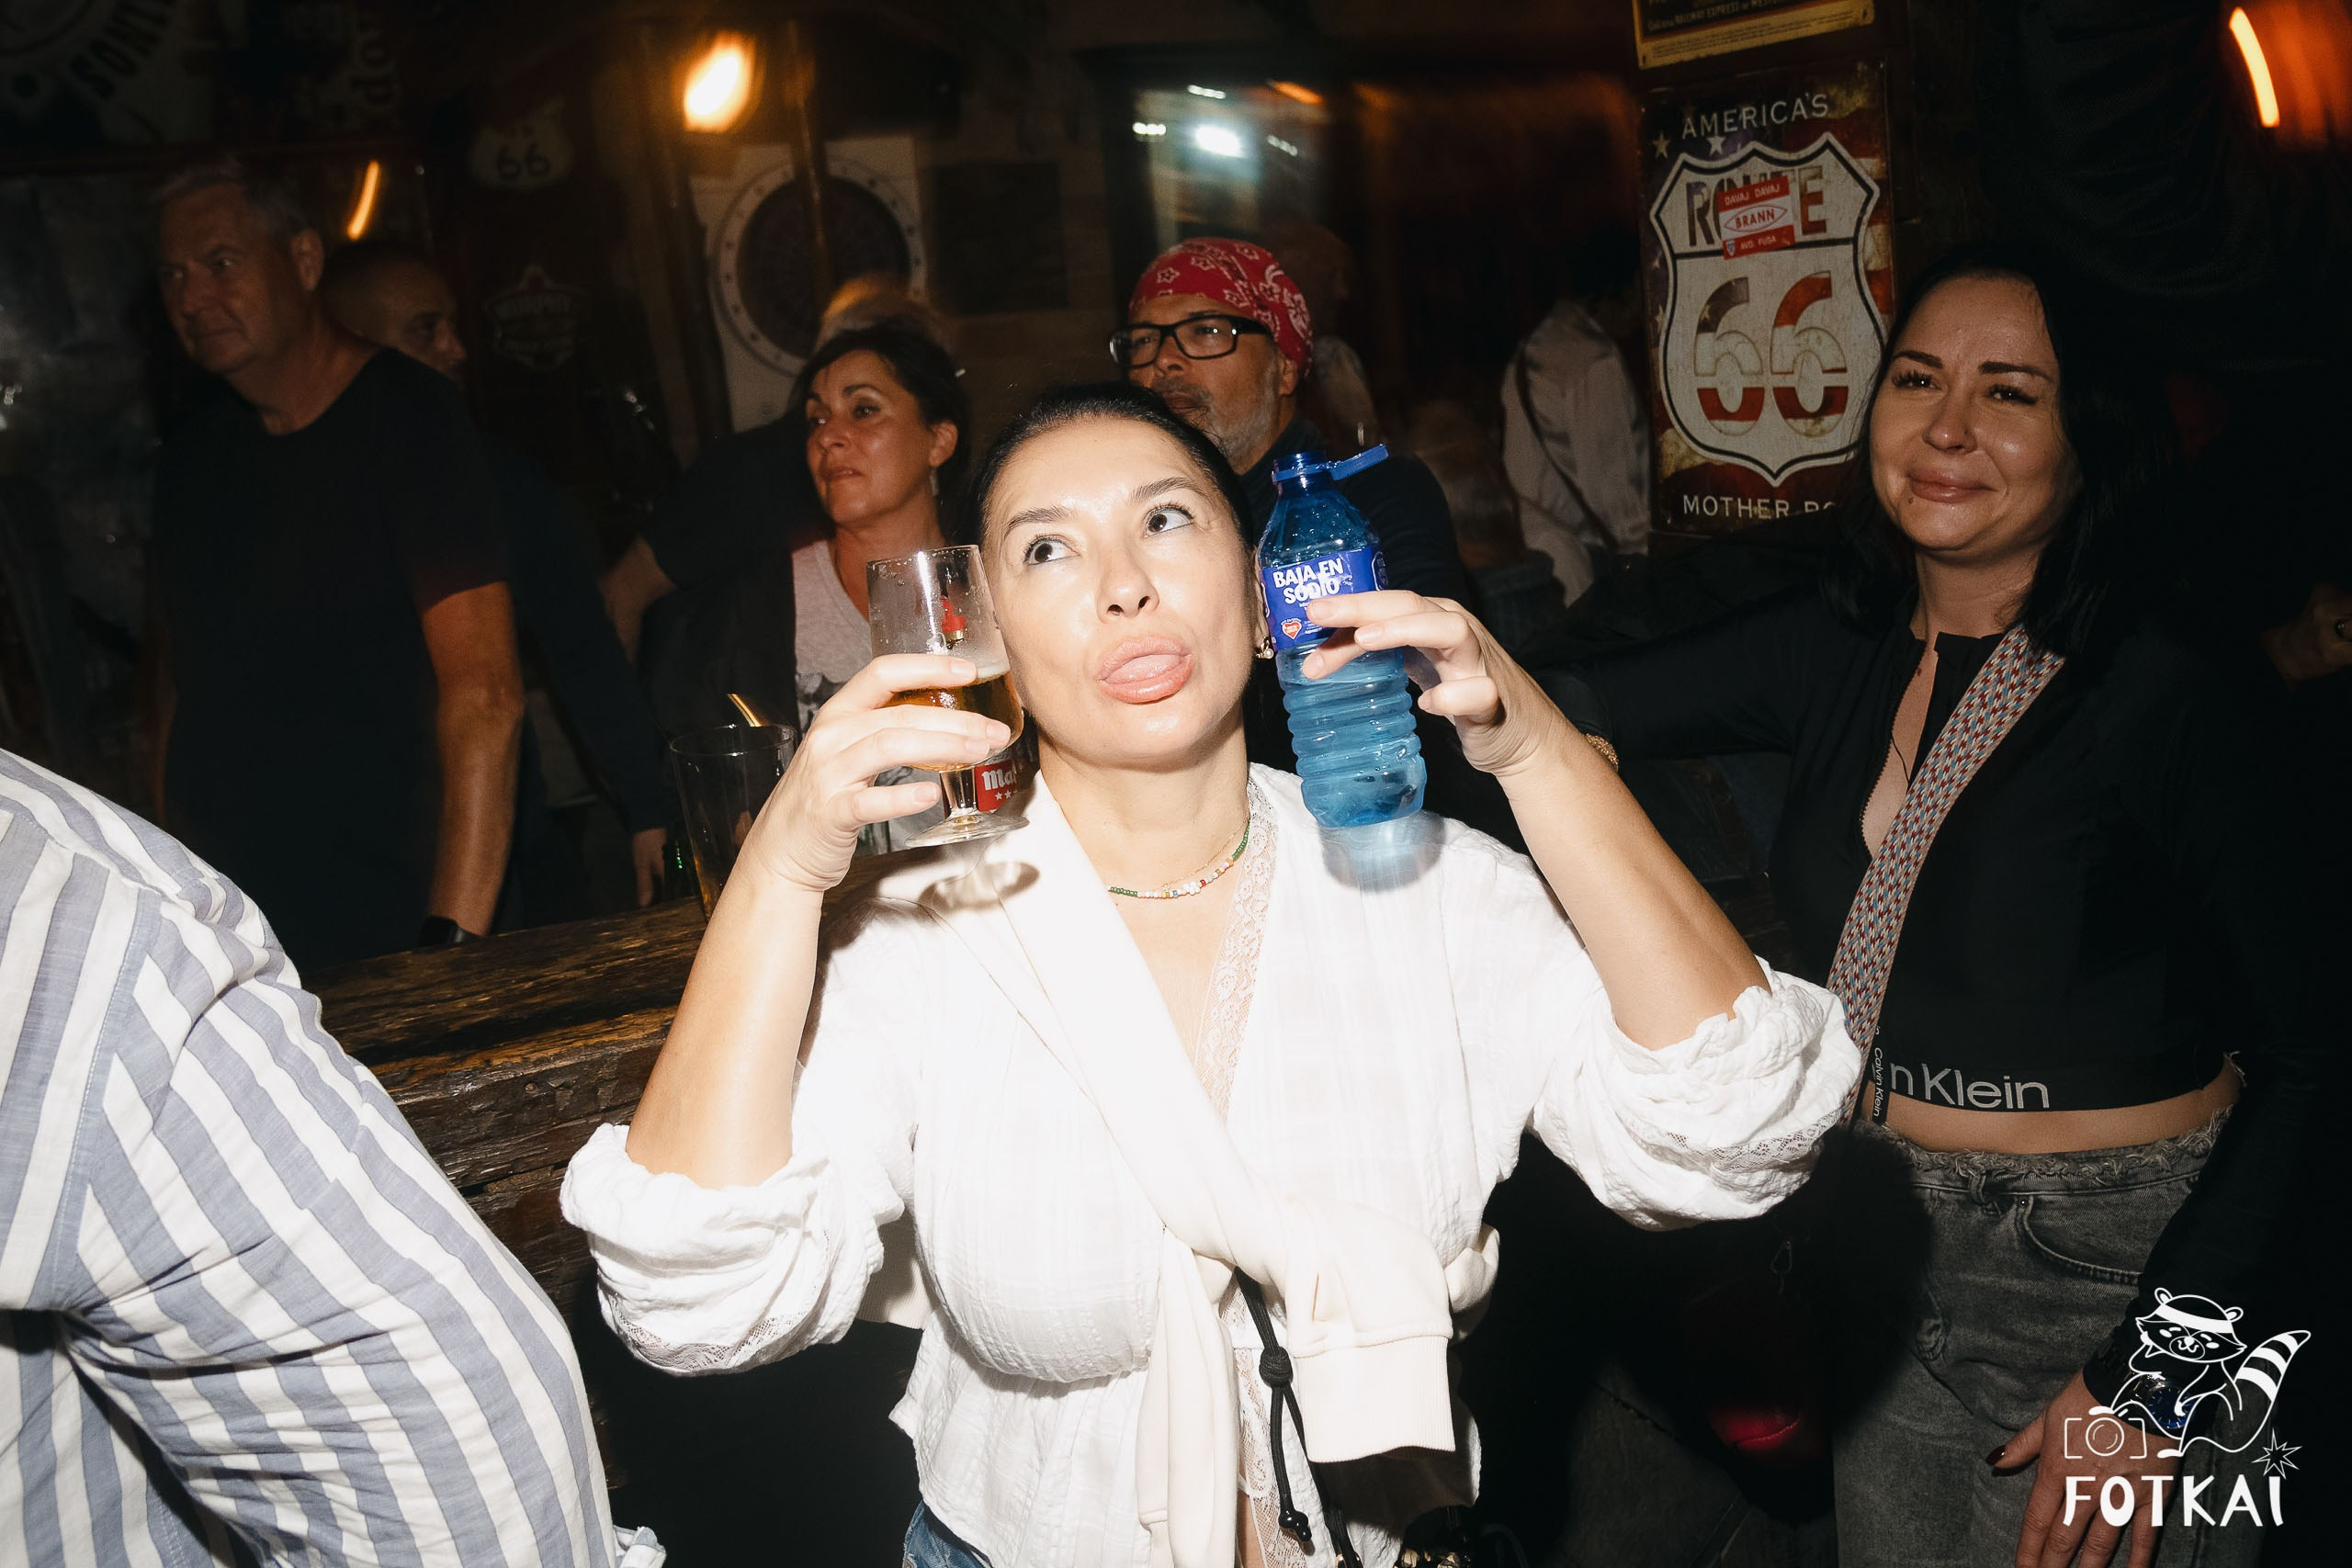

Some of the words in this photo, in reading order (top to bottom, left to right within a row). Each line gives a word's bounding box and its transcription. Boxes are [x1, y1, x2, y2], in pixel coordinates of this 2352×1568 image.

[1682, 93, 1828, 140] AMERICA'S
[497, 141, 550, 181] 66
[1724, 192, 1750, 206] DAVAJ
[1755, 184, 1780, 197] DAVAJ
[1736, 209, 1775, 229] BRANN
[1694, 270, 1849, 438] 66
[1683, 493, 1790, 520] MOTHER
[1273, 565, 1317, 588] BAJA
[1318, 558, 1343, 576] EN
[1874, 1047, 1883, 1086] Calvin
[1873, 1087, 1884, 1117] Klein
[1921, 1063, 2050, 1110] Klein
